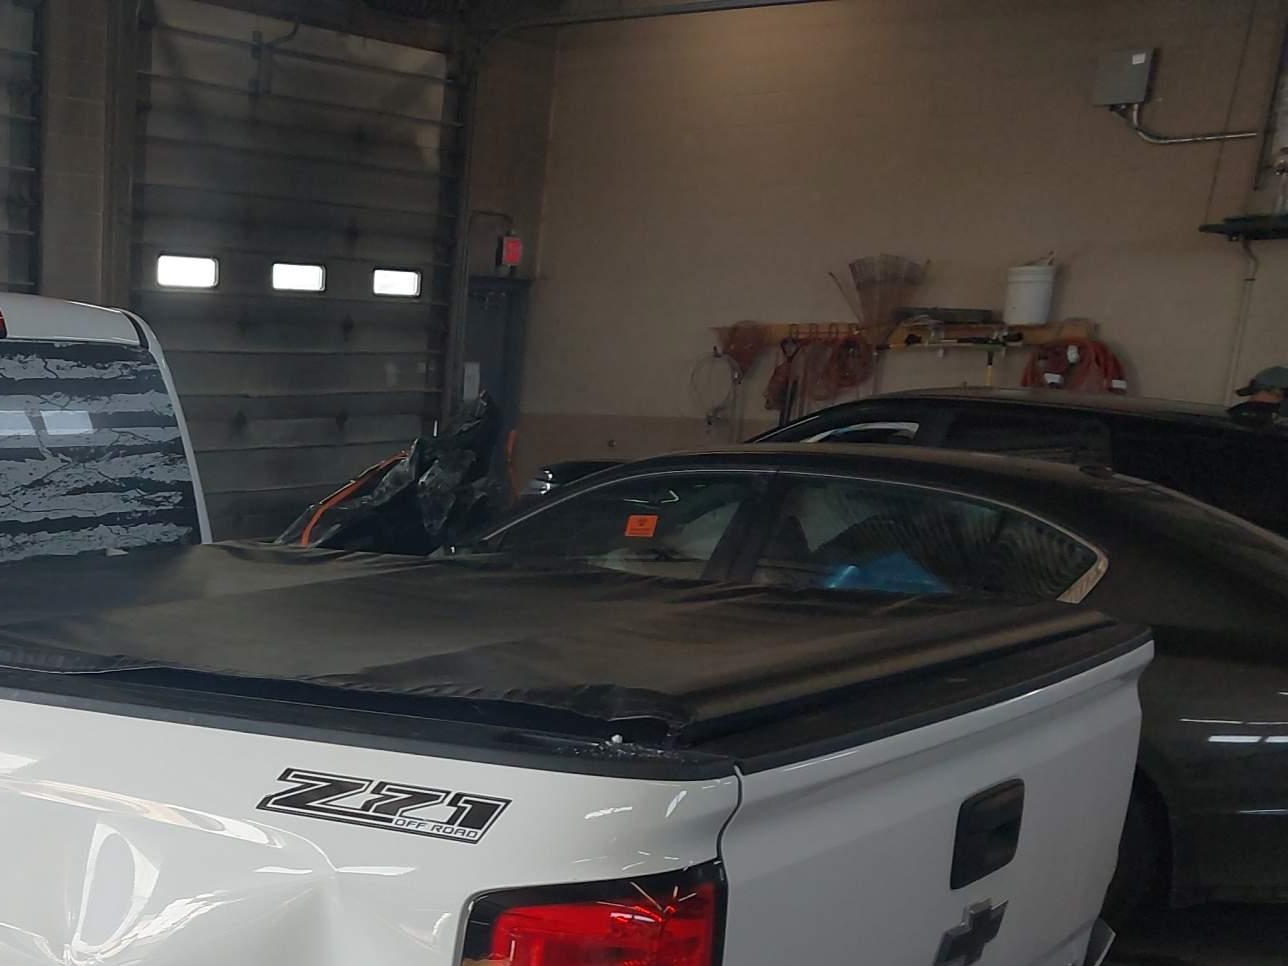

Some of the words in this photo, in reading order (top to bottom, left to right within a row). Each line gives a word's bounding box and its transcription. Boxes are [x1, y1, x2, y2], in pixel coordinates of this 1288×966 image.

[258, 767, 511, 840] Z71
[394, 818, 426, 833] OFF
[431, 823, 479, 839] ROAD
